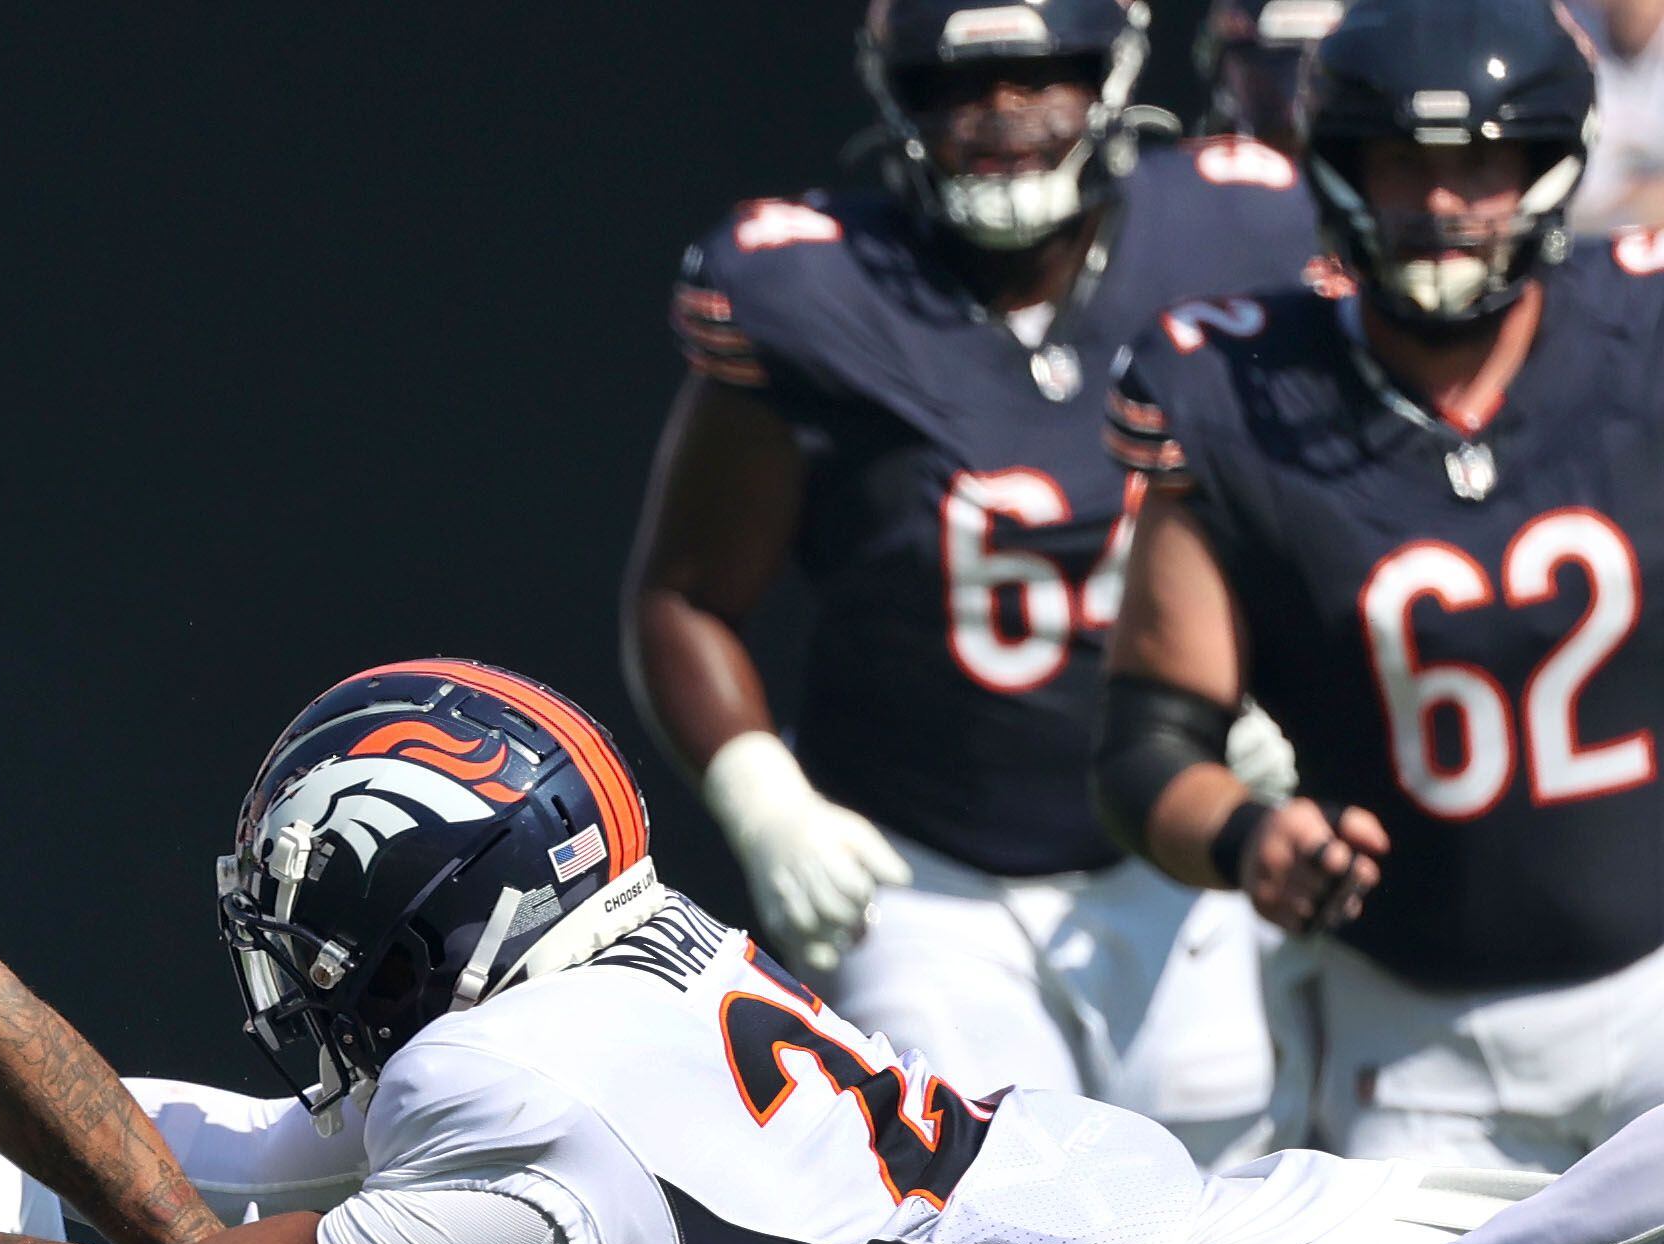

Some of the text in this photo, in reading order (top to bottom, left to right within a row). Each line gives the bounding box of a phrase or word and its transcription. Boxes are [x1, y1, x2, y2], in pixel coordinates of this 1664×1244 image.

[1358, 507, 1655, 820] 62
[604, 881, 643, 913] CHOOSE
[719, 938, 1001, 1213] 2
